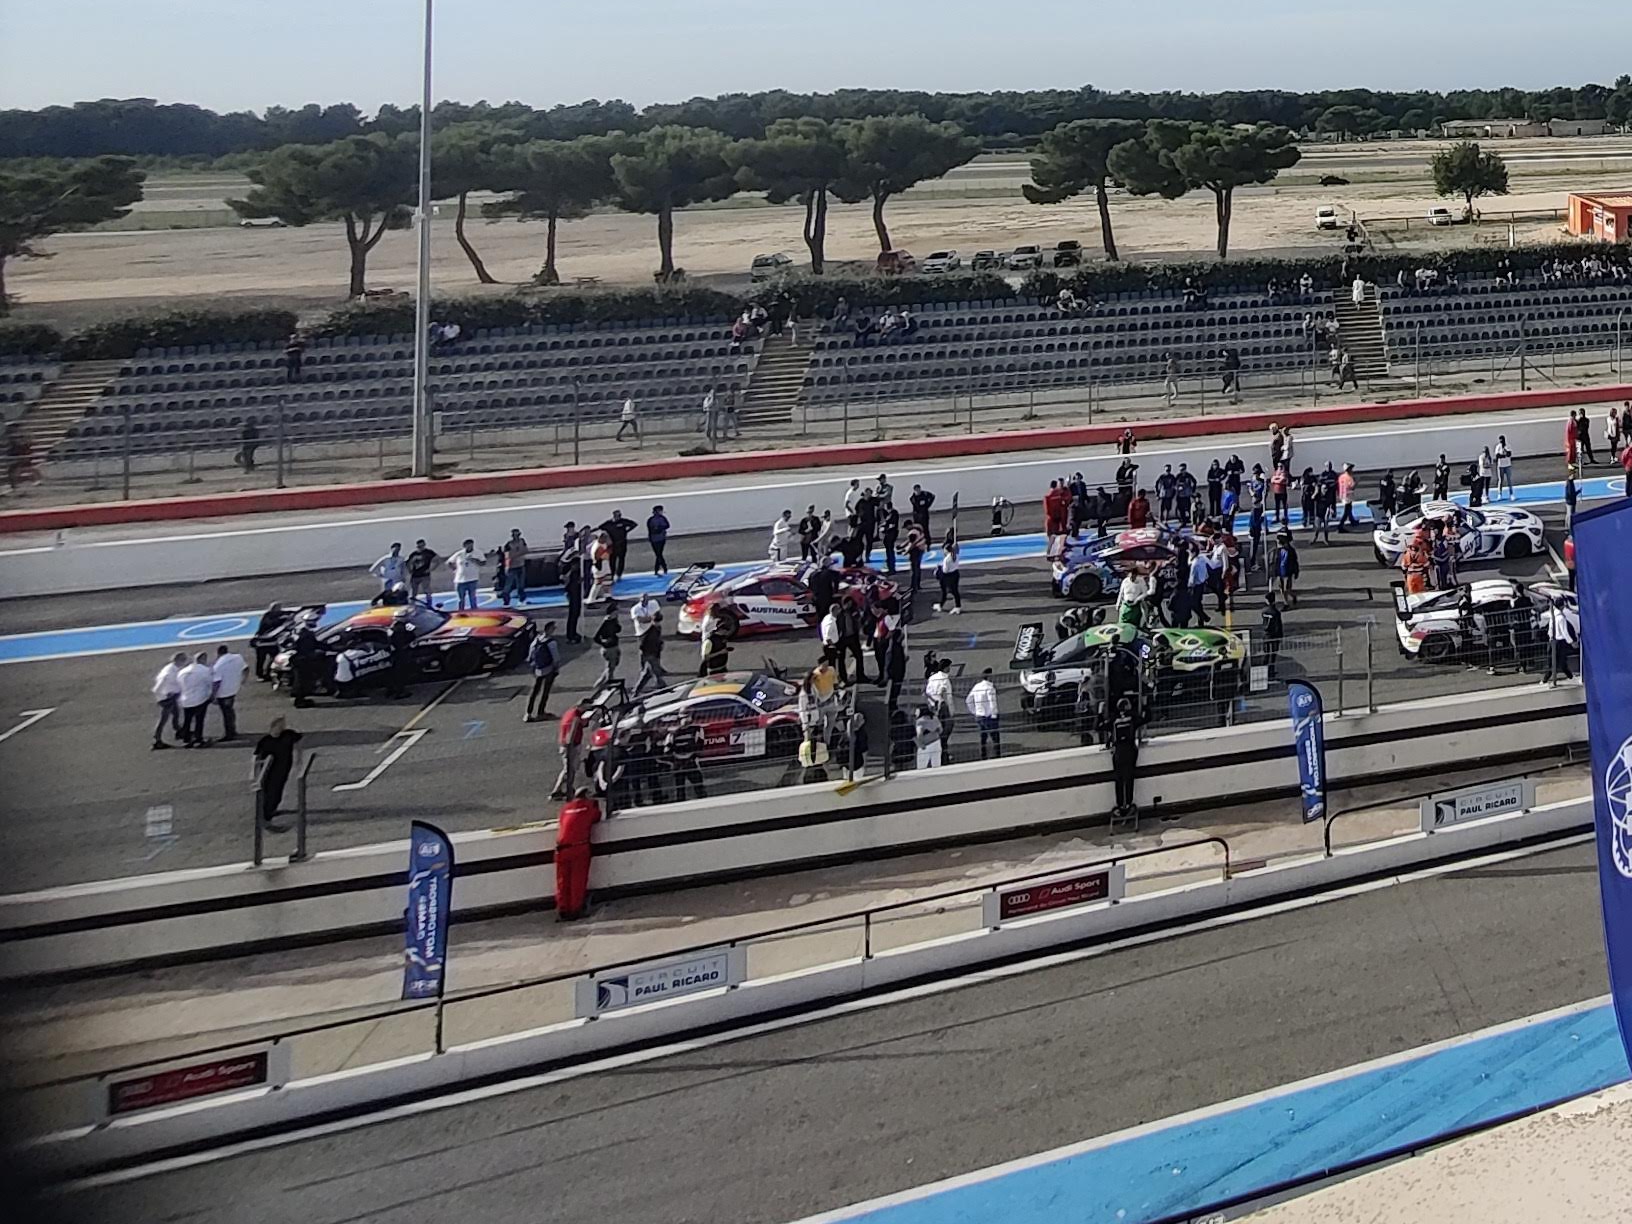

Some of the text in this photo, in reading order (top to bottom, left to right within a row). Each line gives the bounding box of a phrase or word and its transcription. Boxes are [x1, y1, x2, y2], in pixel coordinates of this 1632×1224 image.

[750, 606, 797, 615] AUSTRALIA
[1460, 796, 1517, 816] PAUL RICARD
[1050, 879, 1100, 896] Audi Sport
[635, 961, 720, 985] CIRCUIT
[635, 971, 720, 997] PAUL RICARD
